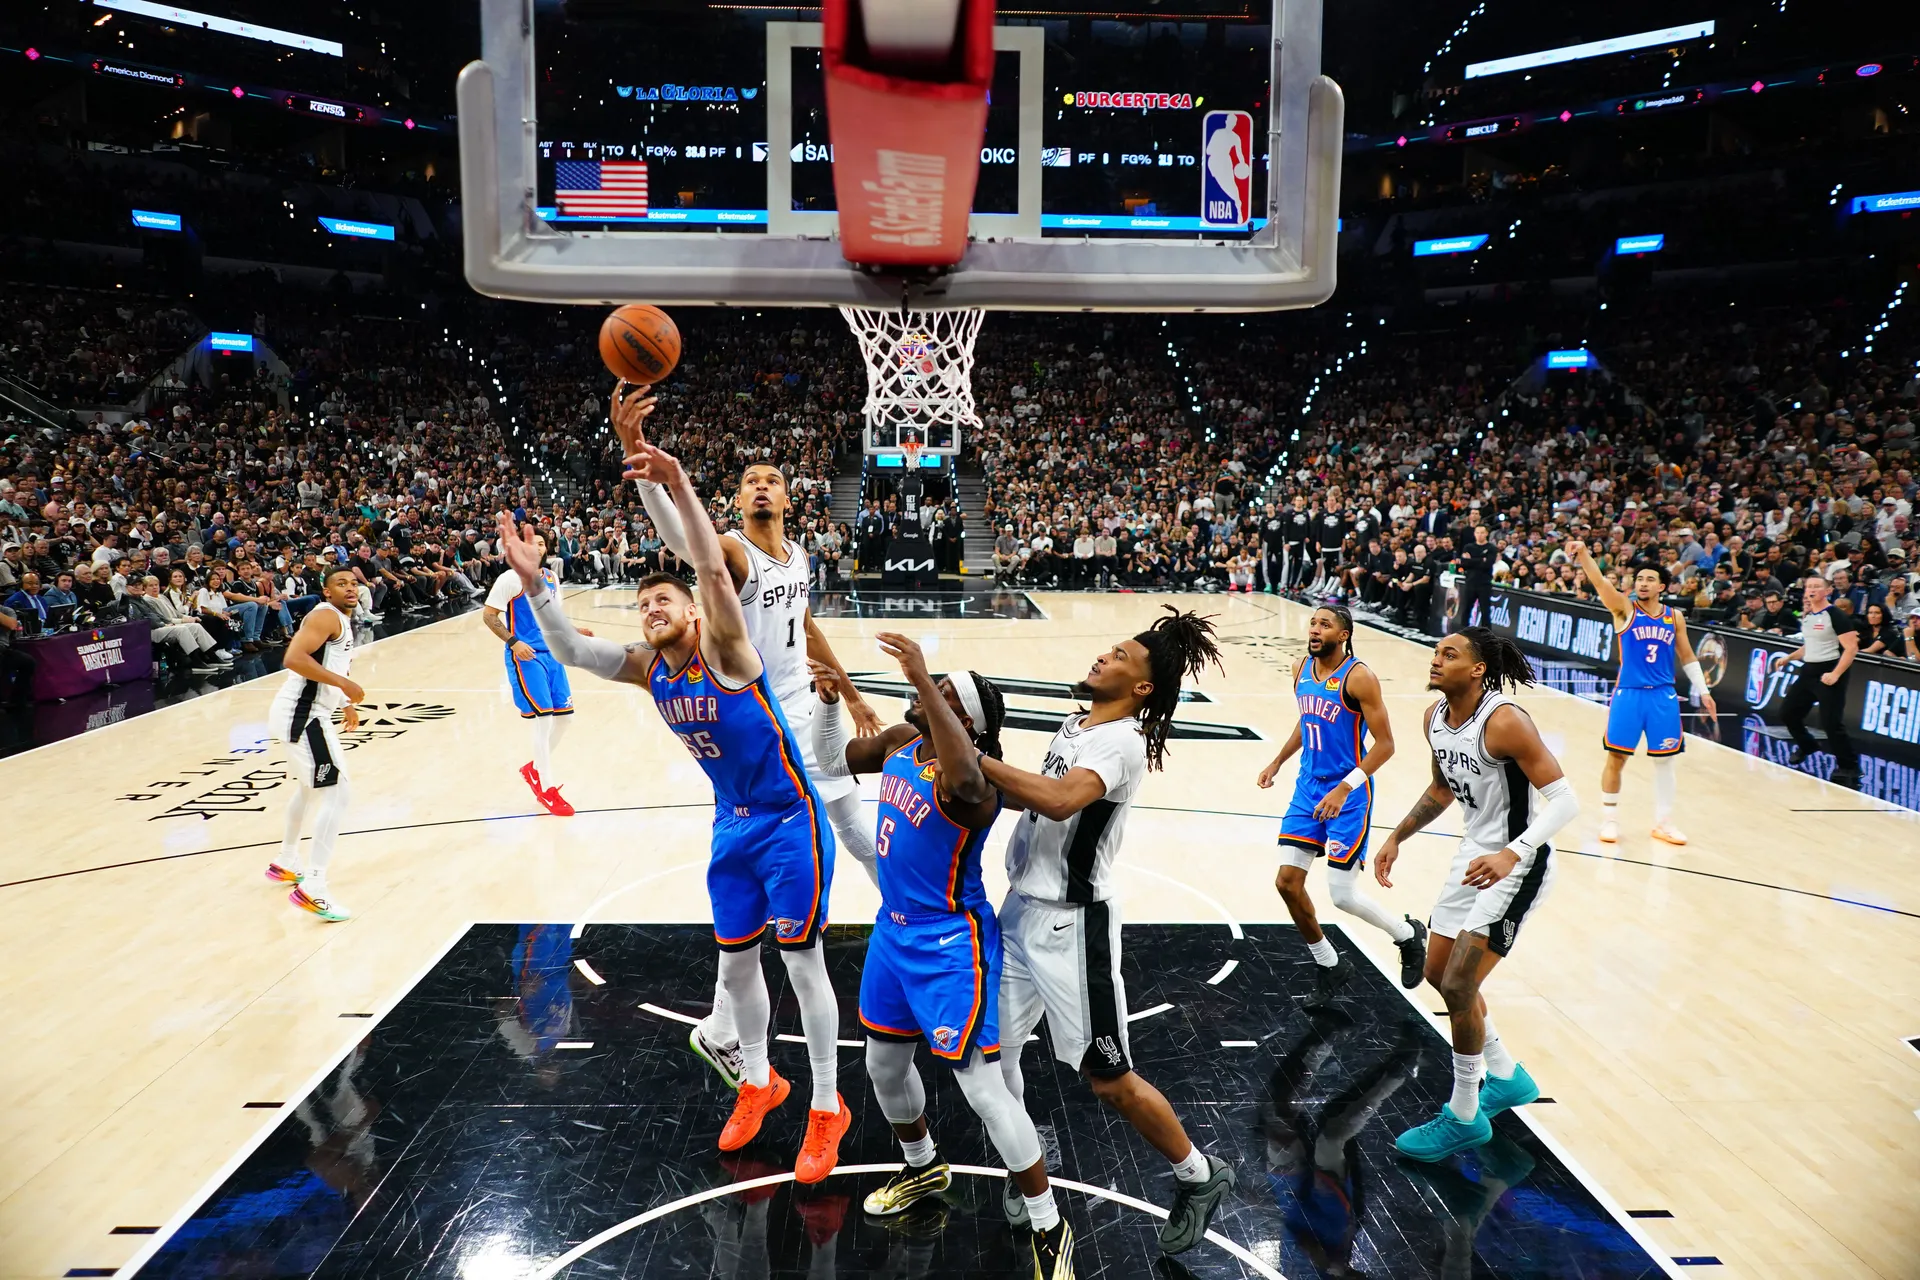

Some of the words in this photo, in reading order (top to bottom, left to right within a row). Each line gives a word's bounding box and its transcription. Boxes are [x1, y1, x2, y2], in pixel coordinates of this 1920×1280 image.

[104, 65, 138, 77] Americus
[140, 71, 173, 84] Diamond
[636, 87, 659, 100] LA
[661, 84, 738, 101] GLORIA
[1076, 91, 1192, 109] BURGERTECA
[1645, 94, 1685, 108] imagine360
[606, 145, 624, 156] TO
[646, 146, 677, 157] FG%
[709, 147, 726, 157] PF
[805, 144, 829, 161] SA
[980, 147, 1016, 164] OKC
[1078, 153, 1096, 164] PF
[1121, 154, 1152, 165] FG%
[1177, 155, 1195, 165] TO
[1209, 200, 1233, 219] NBA
[136, 214, 177, 226] ticketmaster
[335, 222, 378, 236] ticketmaster
[906, 494, 916, 503] GET
[884, 558, 934, 571] KIA
[785, 617, 796, 649] 1
[1516, 605, 1548, 645] BEGIN
[1548, 611, 1573, 651] WED
[1572, 617, 1603, 660] JUNE
[1602, 623, 1613, 662] 3
[1632, 625, 1675, 646] THUNDER
[76, 641, 105, 655] SUNDAY
[104, 638, 123, 649] NIGHT
[1645, 644, 1659, 664] 3
[81, 647, 125, 672] BASKETBALL
[1305, 722, 1323, 751] 11
[880, 774, 932, 829] HUNDER
[1447, 776, 1479, 810] 24
[877, 816, 896, 858] 5
